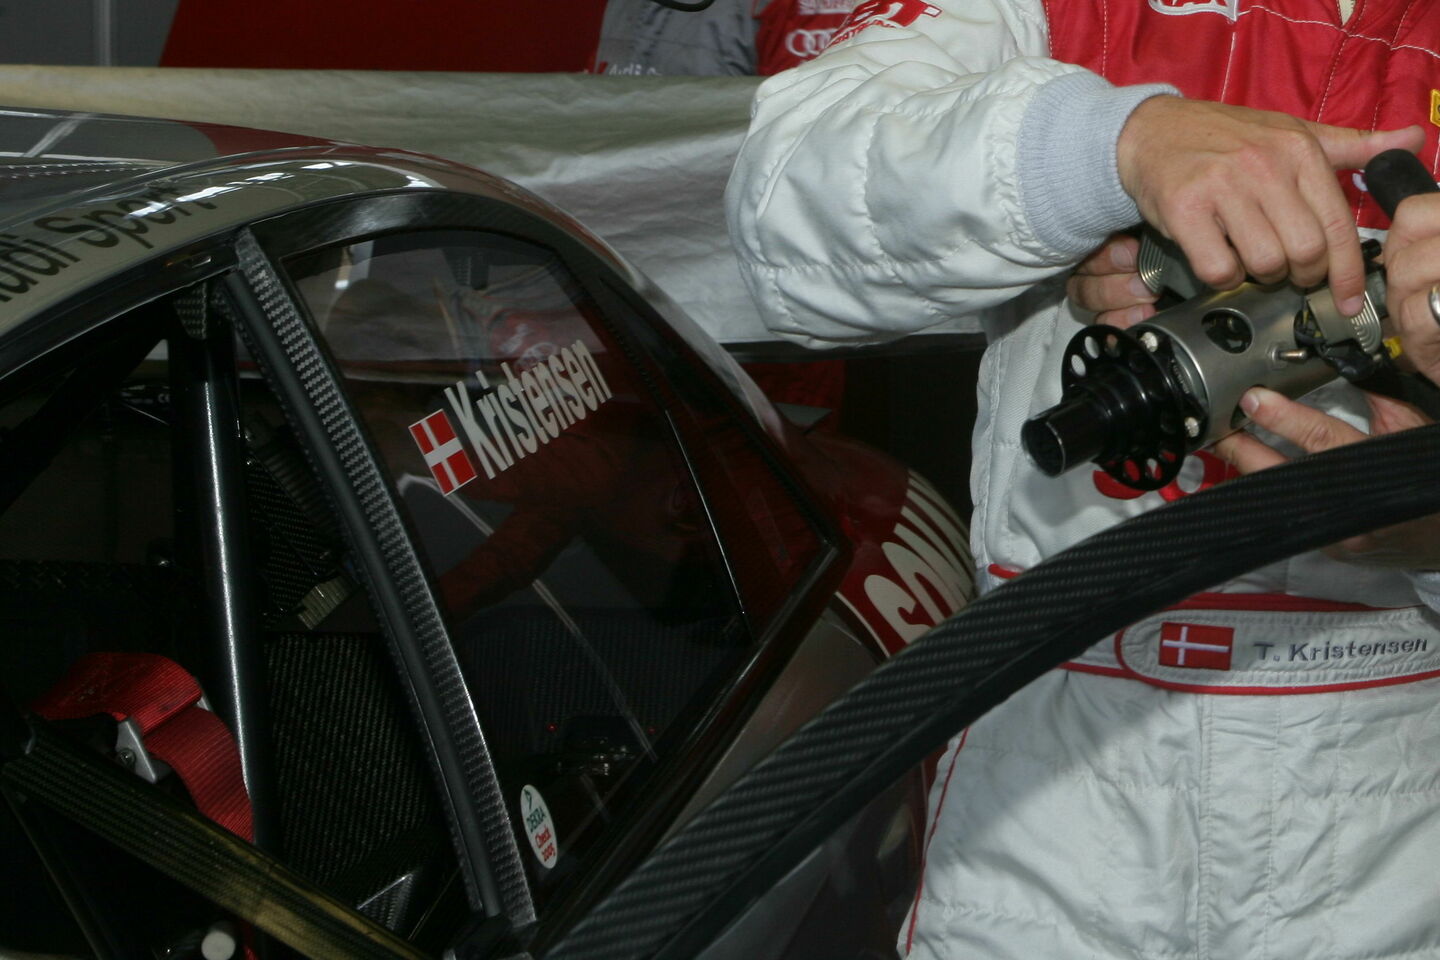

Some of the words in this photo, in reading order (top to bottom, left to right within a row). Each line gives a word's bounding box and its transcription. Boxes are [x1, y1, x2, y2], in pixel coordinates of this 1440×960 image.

[34, 183, 218, 249] Sport
[444, 339, 613, 480] Kristensen
[1253, 642, 1281, 662] T.
[1288, 638, 1428, 662] Kristensen
